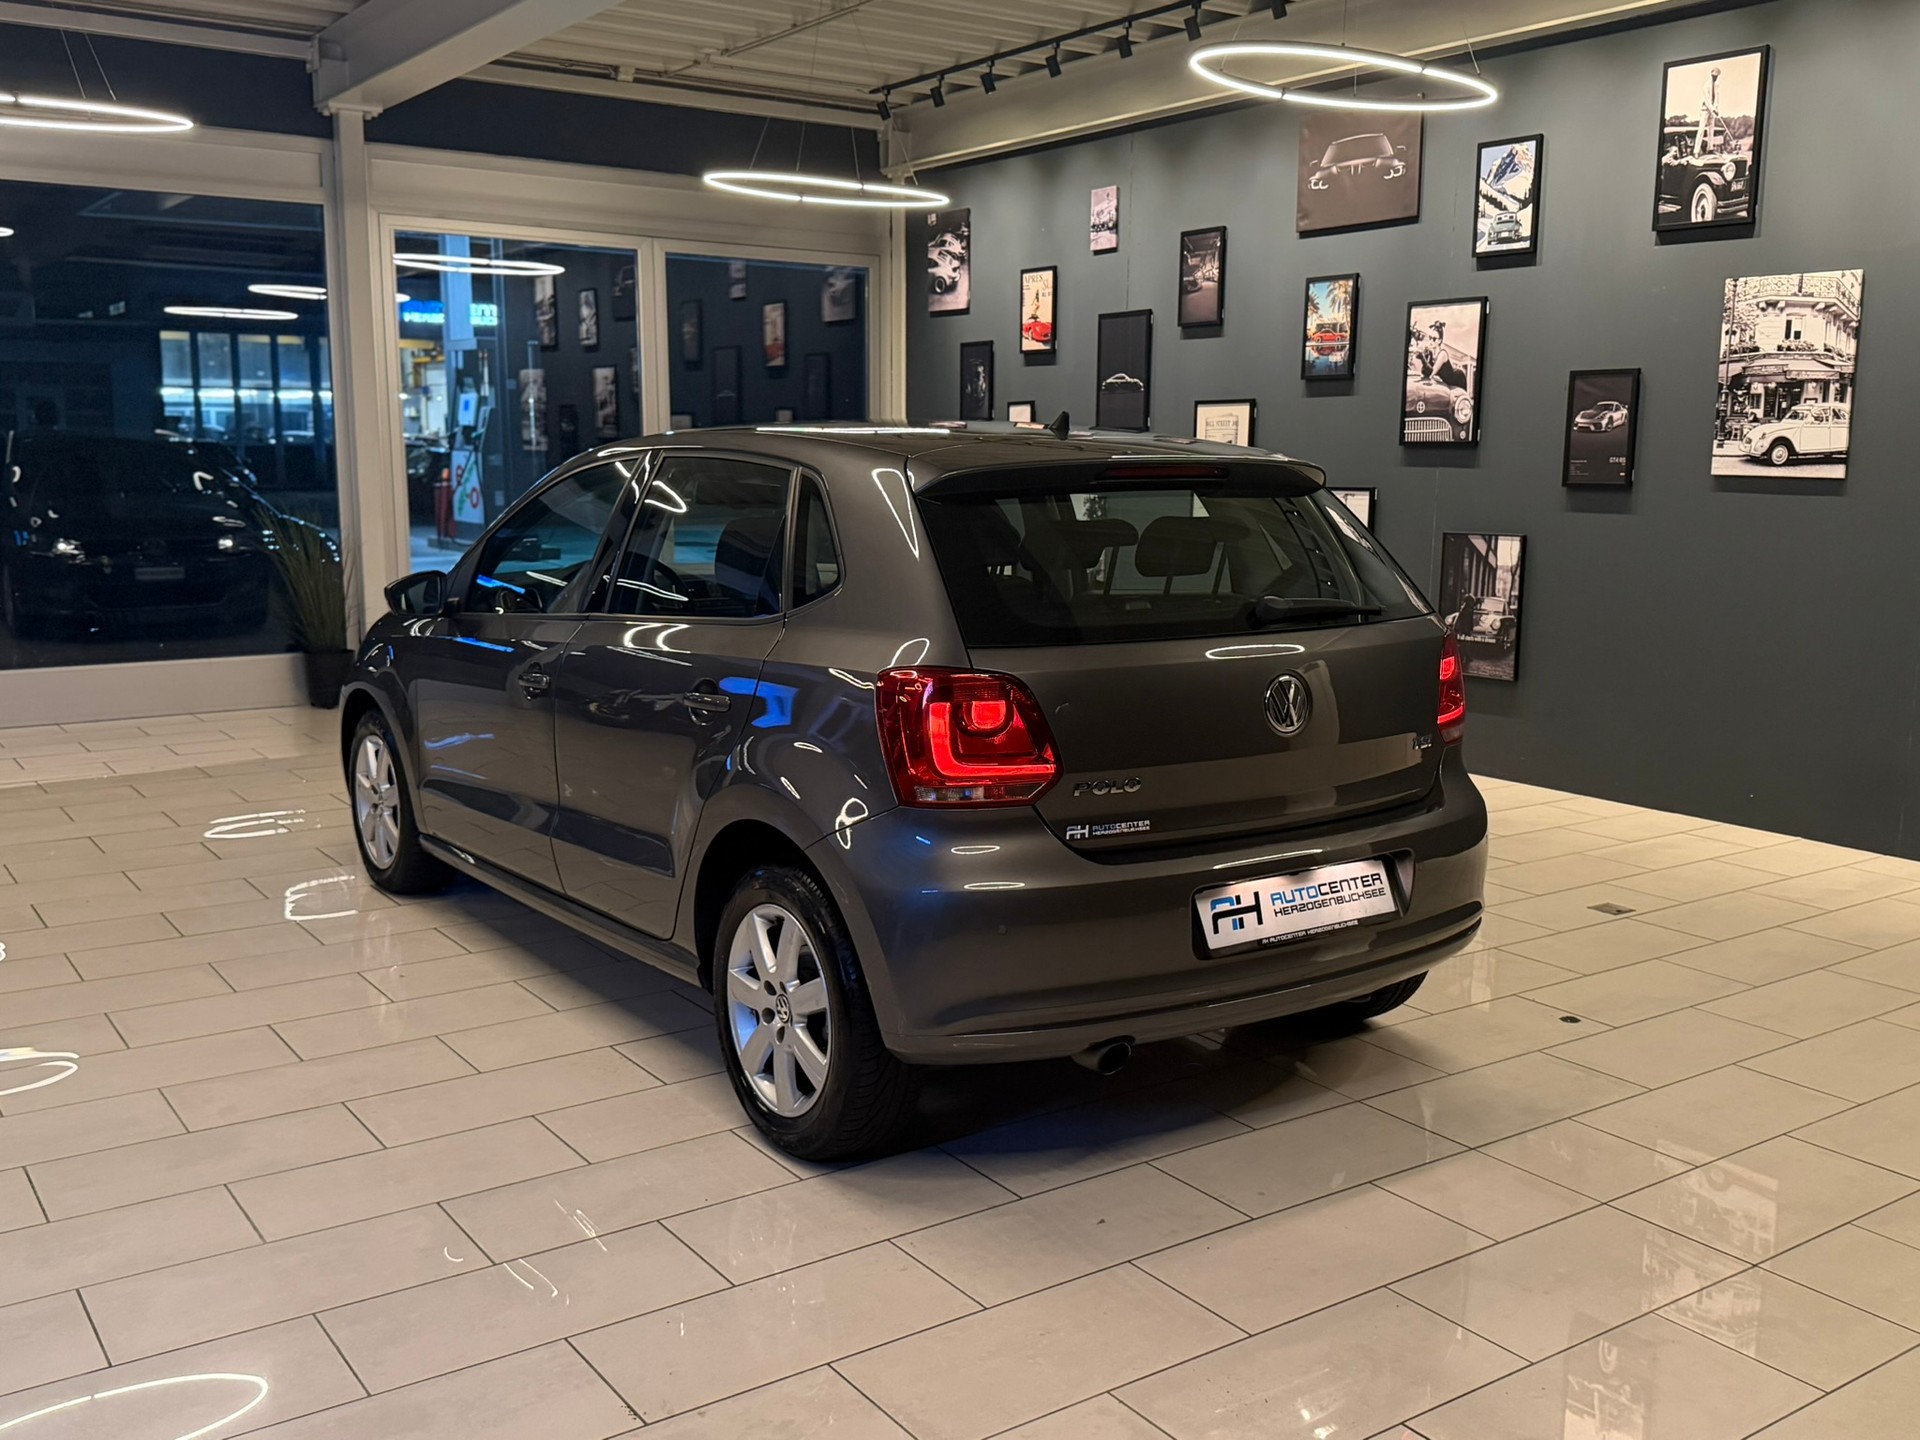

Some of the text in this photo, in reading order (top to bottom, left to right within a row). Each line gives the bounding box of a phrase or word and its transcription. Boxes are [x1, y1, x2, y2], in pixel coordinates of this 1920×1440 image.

[1073, 777, 1141, 797] POLO
[1092, 820, 1150, 831] AUTOCENTER
[1270, 872, 1383, 907] AUTOCENTER
[1273, 887, 1387, 918] HERZOGENBUCHSEE
[1269, 930, 1307, 944] AUTOCENTER
[1307, 920, 1360, 936] HERZOGENBUCHSEE
